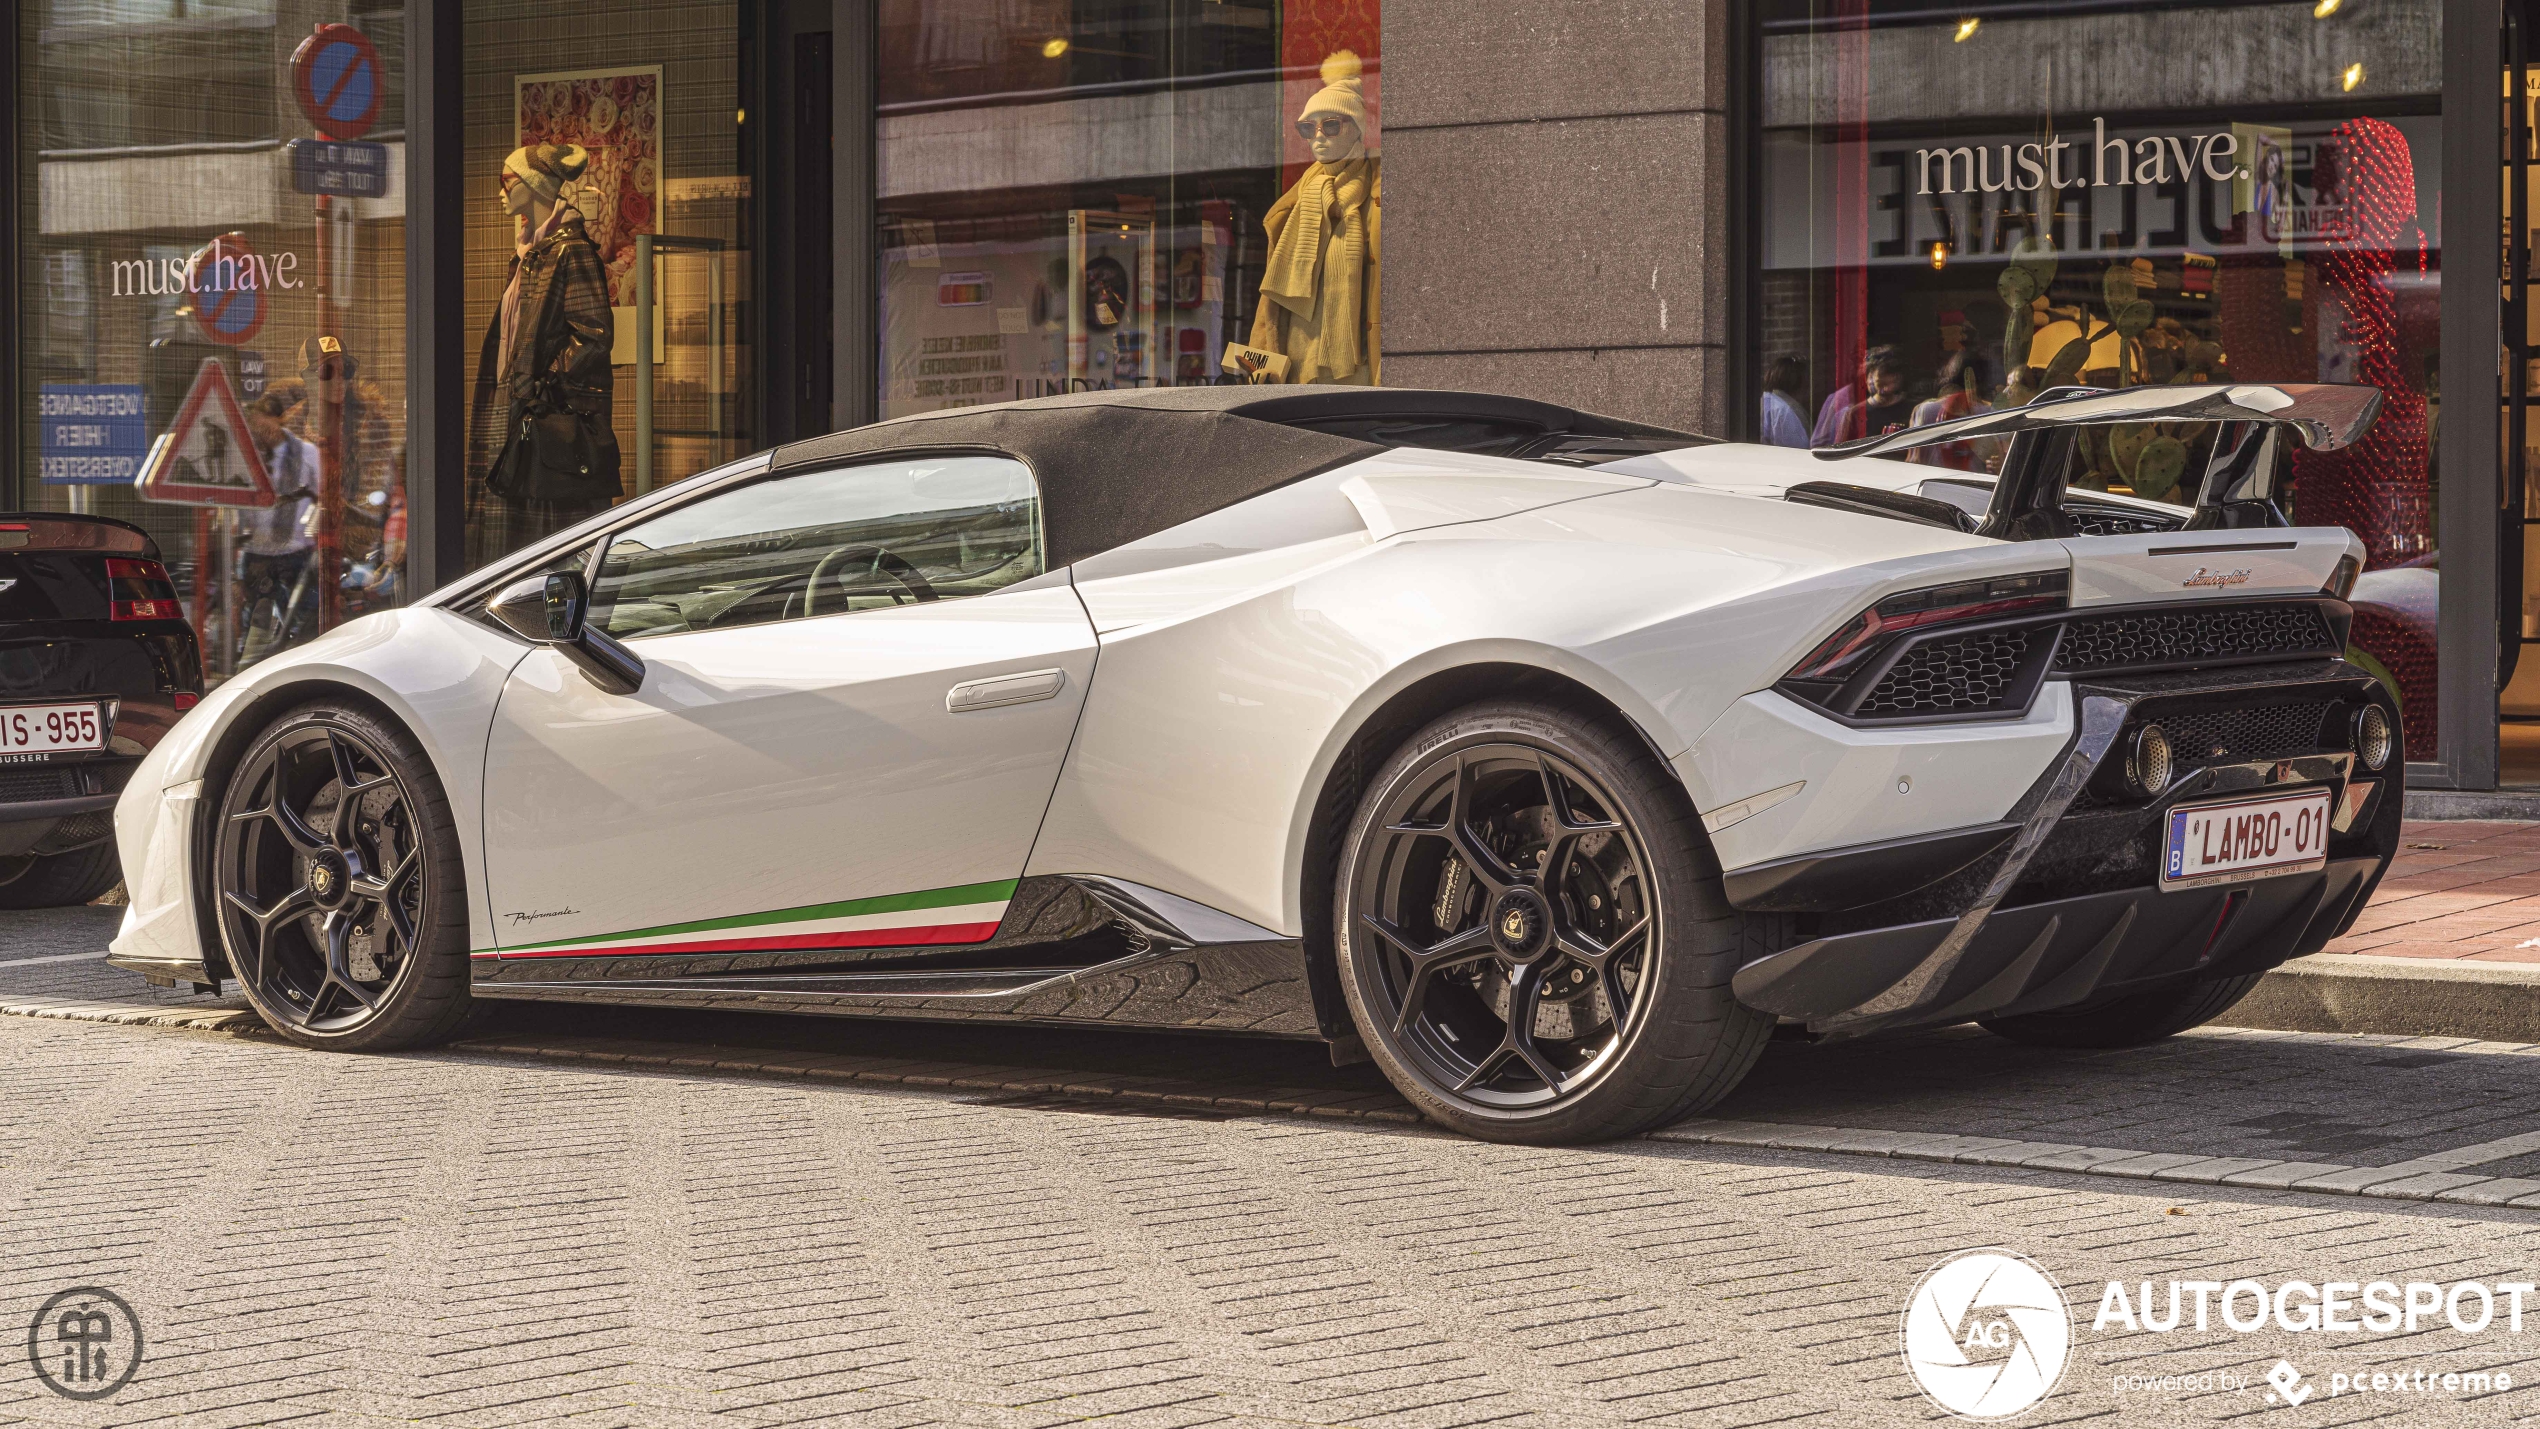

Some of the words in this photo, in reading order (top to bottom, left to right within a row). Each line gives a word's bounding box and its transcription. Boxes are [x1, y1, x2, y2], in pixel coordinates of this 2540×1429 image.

[1916, 117, 2249, 195] must.have.
[111, 239, 304, 296] must.have.
[2183, 567, 2252, 589] Lamborghini
[2202, 806, 2323, 864] LAMBO-01
[2170, 850, 2181, 872] B
[2186, 876, 2222, 888] LAMBORGHINI
[2230, 871, 2256, 882] BRUSSELS
[503, 906, 581, 927] Performante
